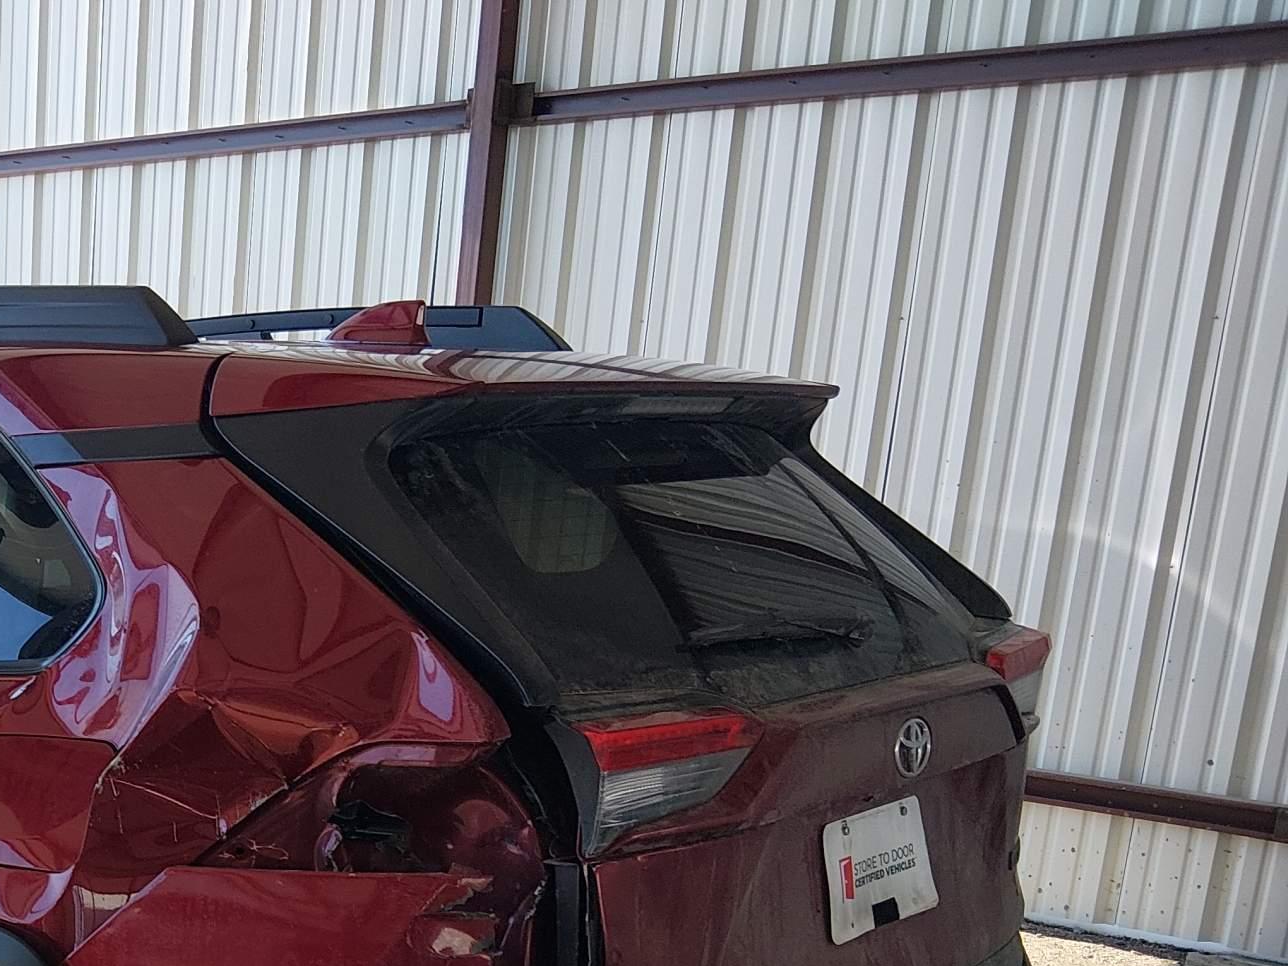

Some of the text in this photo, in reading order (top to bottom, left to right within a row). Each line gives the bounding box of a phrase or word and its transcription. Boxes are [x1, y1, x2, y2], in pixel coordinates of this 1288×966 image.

[854, 843, 914, 876] STORE TO DOOR
[855, 858, 916, 888] CERTIFIED VEHICLES
